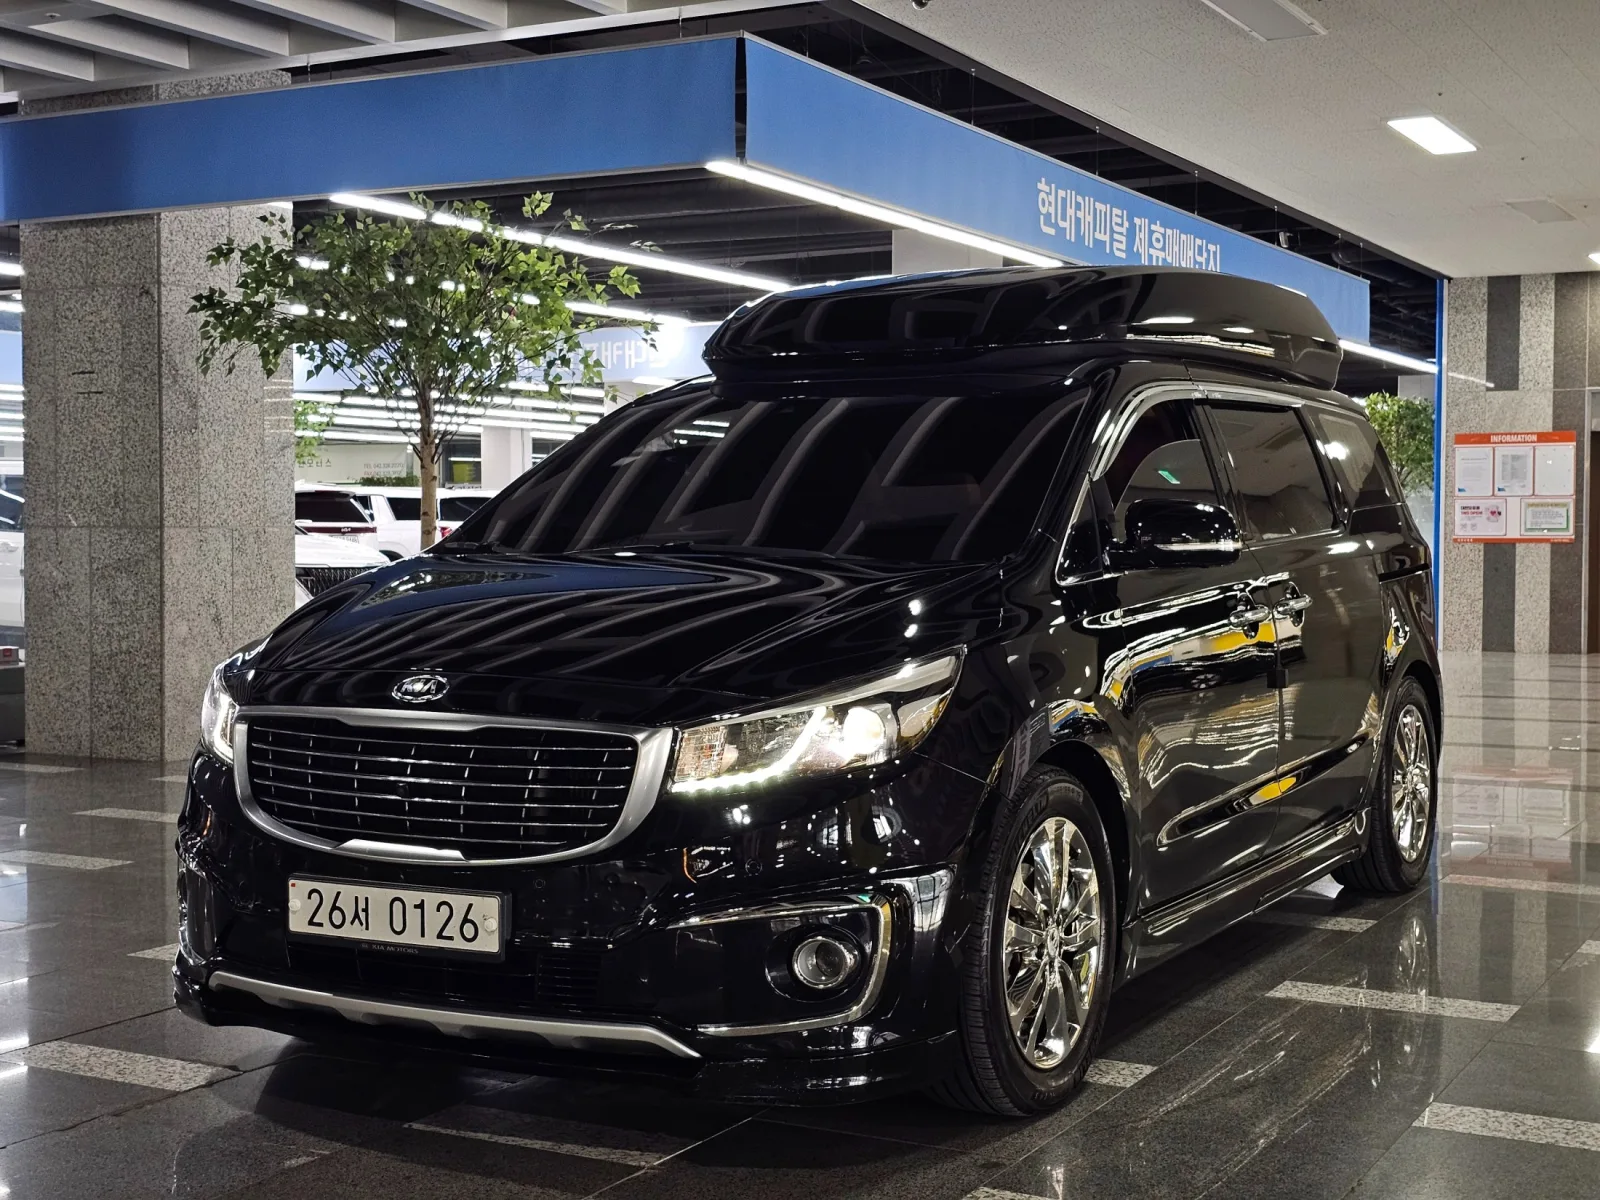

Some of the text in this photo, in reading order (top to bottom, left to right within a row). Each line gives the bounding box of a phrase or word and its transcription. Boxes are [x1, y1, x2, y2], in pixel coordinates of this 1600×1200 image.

[1037, 178, 1221, 272] 현대캐피탈 제휴매매단지
[1490, 434, 1538, 443] INFORMATION
[307, 888, 480, 943] 26서 0126
[386, 946, 419, 954] MOTORS
